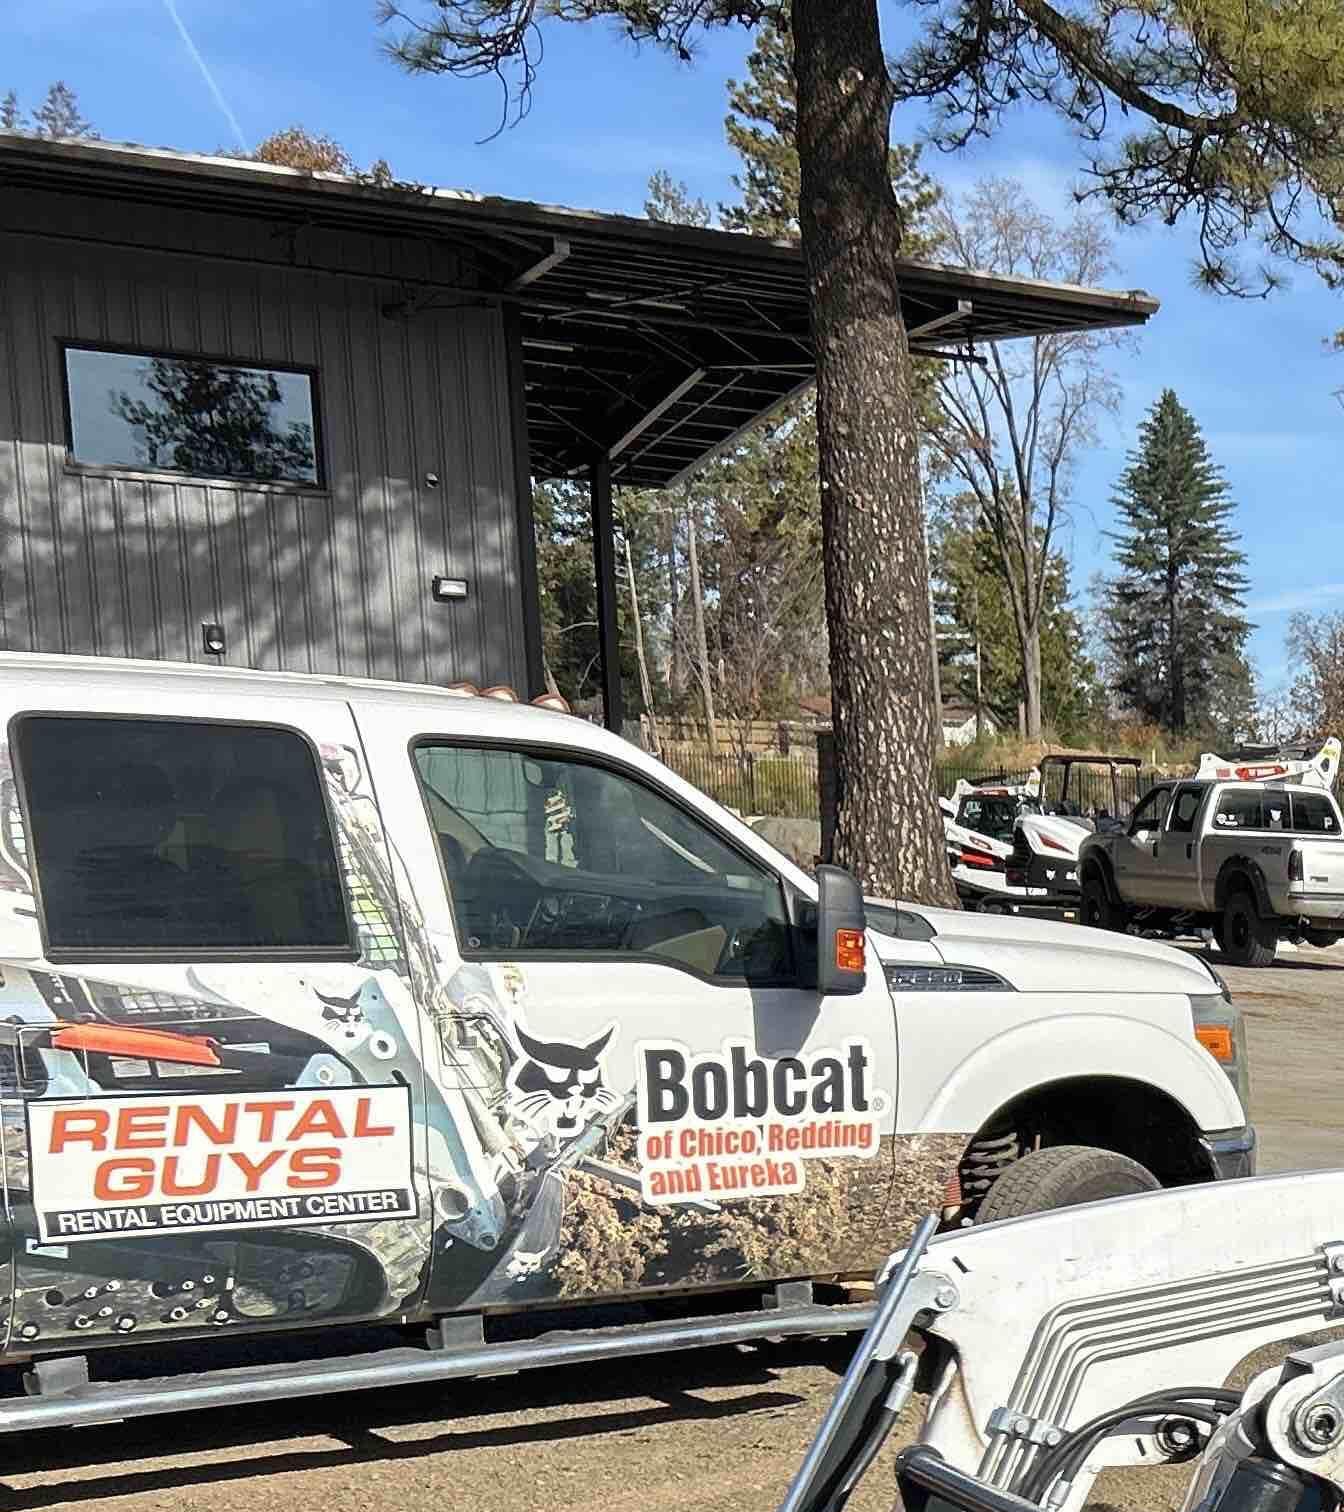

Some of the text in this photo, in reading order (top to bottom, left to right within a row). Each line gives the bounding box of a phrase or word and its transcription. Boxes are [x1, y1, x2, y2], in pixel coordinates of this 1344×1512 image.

[644, 1045, 868, 1123] Bobcat
[48, 1098, 395, 1154] RENTAL
[646, 1120, 872, 1160] of Chico, Redding
[94, 1147, 341, 1201] GUYS
[650, 1159, 797, 1196] and Eureka
[58, 1191, 399, 1233] RENTAL EQUIPMENT CENTER
